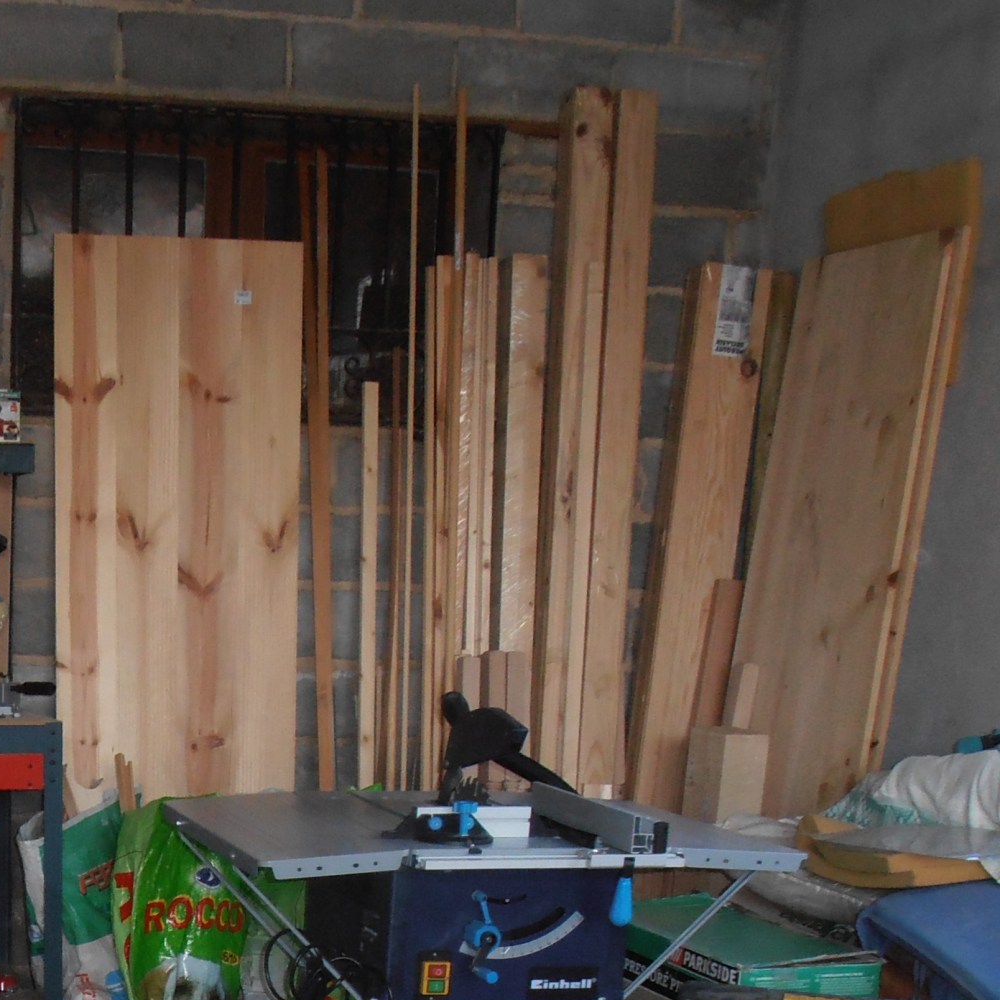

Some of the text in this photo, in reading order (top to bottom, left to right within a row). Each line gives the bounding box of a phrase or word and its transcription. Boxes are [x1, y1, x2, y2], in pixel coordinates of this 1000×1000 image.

[144, 894, 246, 935] ROCCO
[530, 977, 592, 990] Einhell
[682, 951, 739, 985] PARKSIDE
